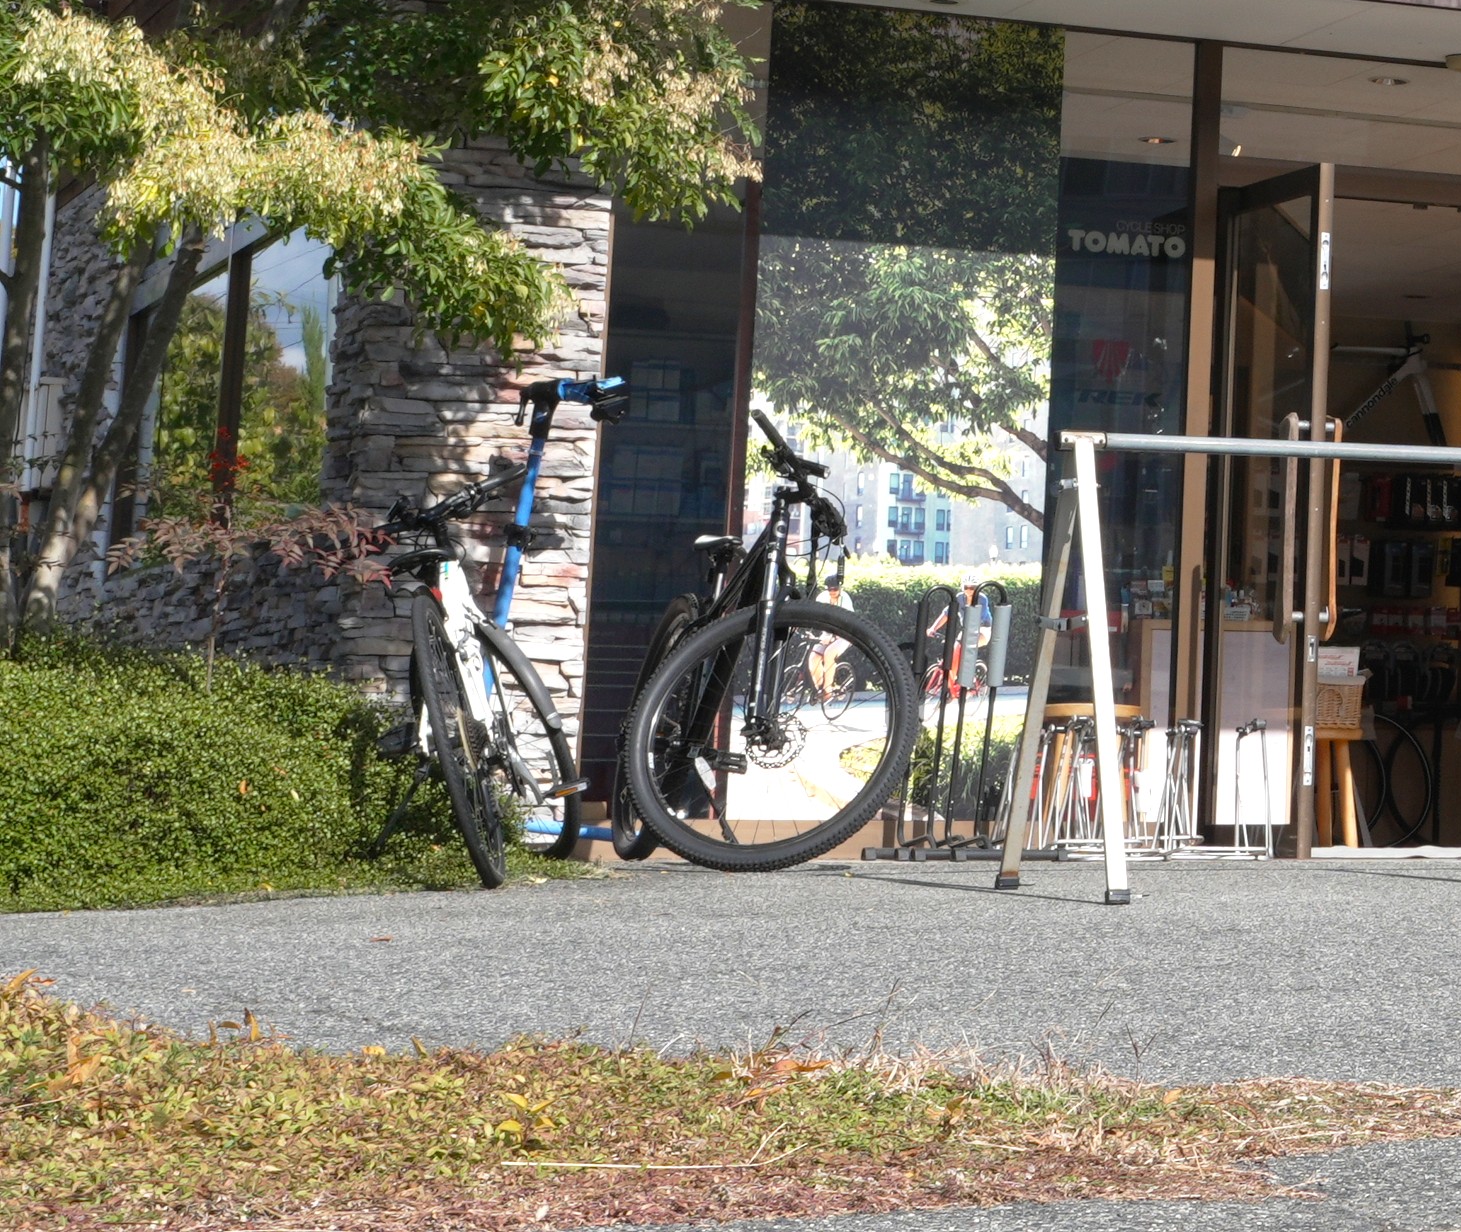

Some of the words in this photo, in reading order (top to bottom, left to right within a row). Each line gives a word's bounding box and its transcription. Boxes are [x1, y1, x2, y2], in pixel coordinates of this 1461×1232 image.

[1115, 220, 1151, 234] CYCLE
[1153, 223, 1186, 236] SHOP
[1068, 229, 1186, 258] TOMATO
[1346, 377, 1398, 428] cannondale
